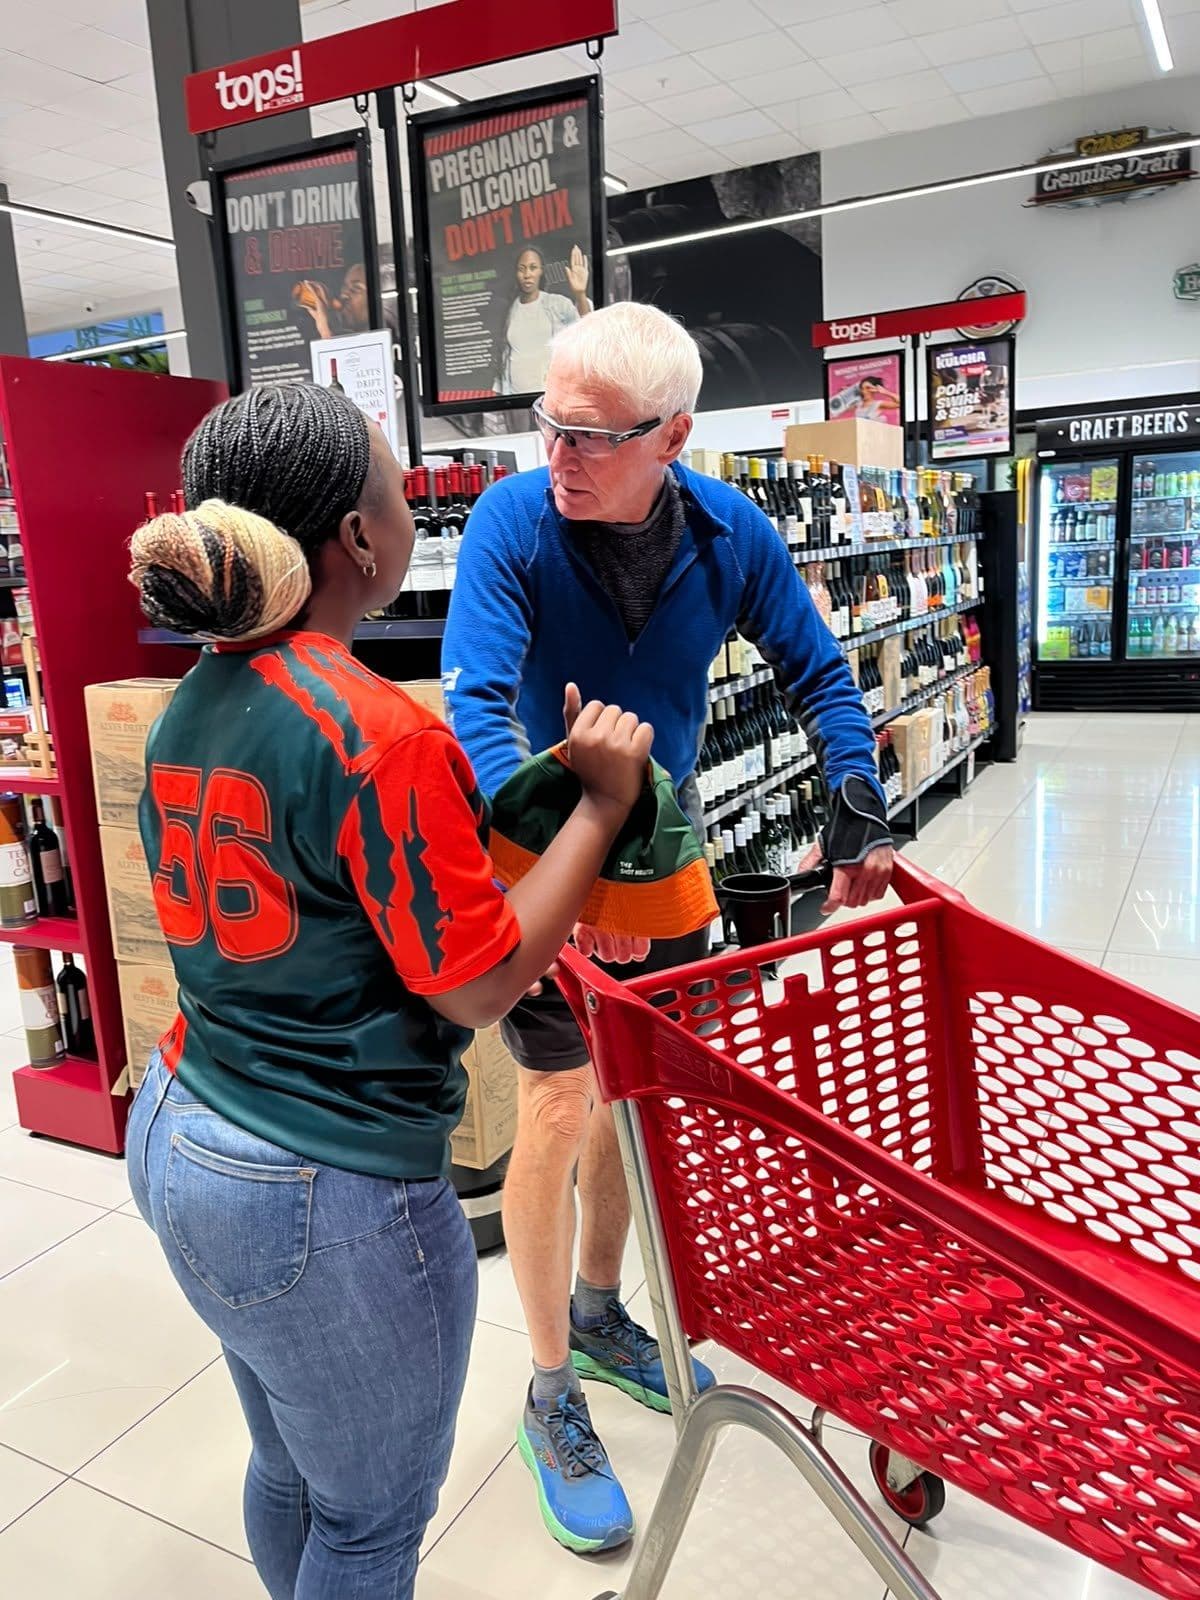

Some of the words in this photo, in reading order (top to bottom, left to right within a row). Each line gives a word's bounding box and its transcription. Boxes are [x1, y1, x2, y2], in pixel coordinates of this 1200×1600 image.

[215, 50, 303, 112] tops!
[430, 119, 554, 193] PREGNANCY
[563, 115, 580, 148] &
[1042, 162, 1124, 191] Genuine
[1124, 149, 1181, 178] Draft
[226, 191, 286, 234] DON'T
[290, 181, 361, 226] DRINK
[460, 158, 557, 219] ALCOHOL
[445, 207, 514, 262] DON'T
[519, 188, 573, 239] MIX
[244, 236, 263, 275] &
[268, 224, 345, 274] DRIVE
[829, 316, 876, 341] tops!
[355, 388, 385, 399] FUSION
[356, 378, 383, 388] DRIFT
[935, 392, 981, 409] SWIRL
[934, 409, 948, 421] &
[948, 405, 974, 419] SIP
[1069, 417, 1127, 442] CRAFT
[1131, 411, 1189, 437] BEERS
[151, 763, 298, 963] 56
